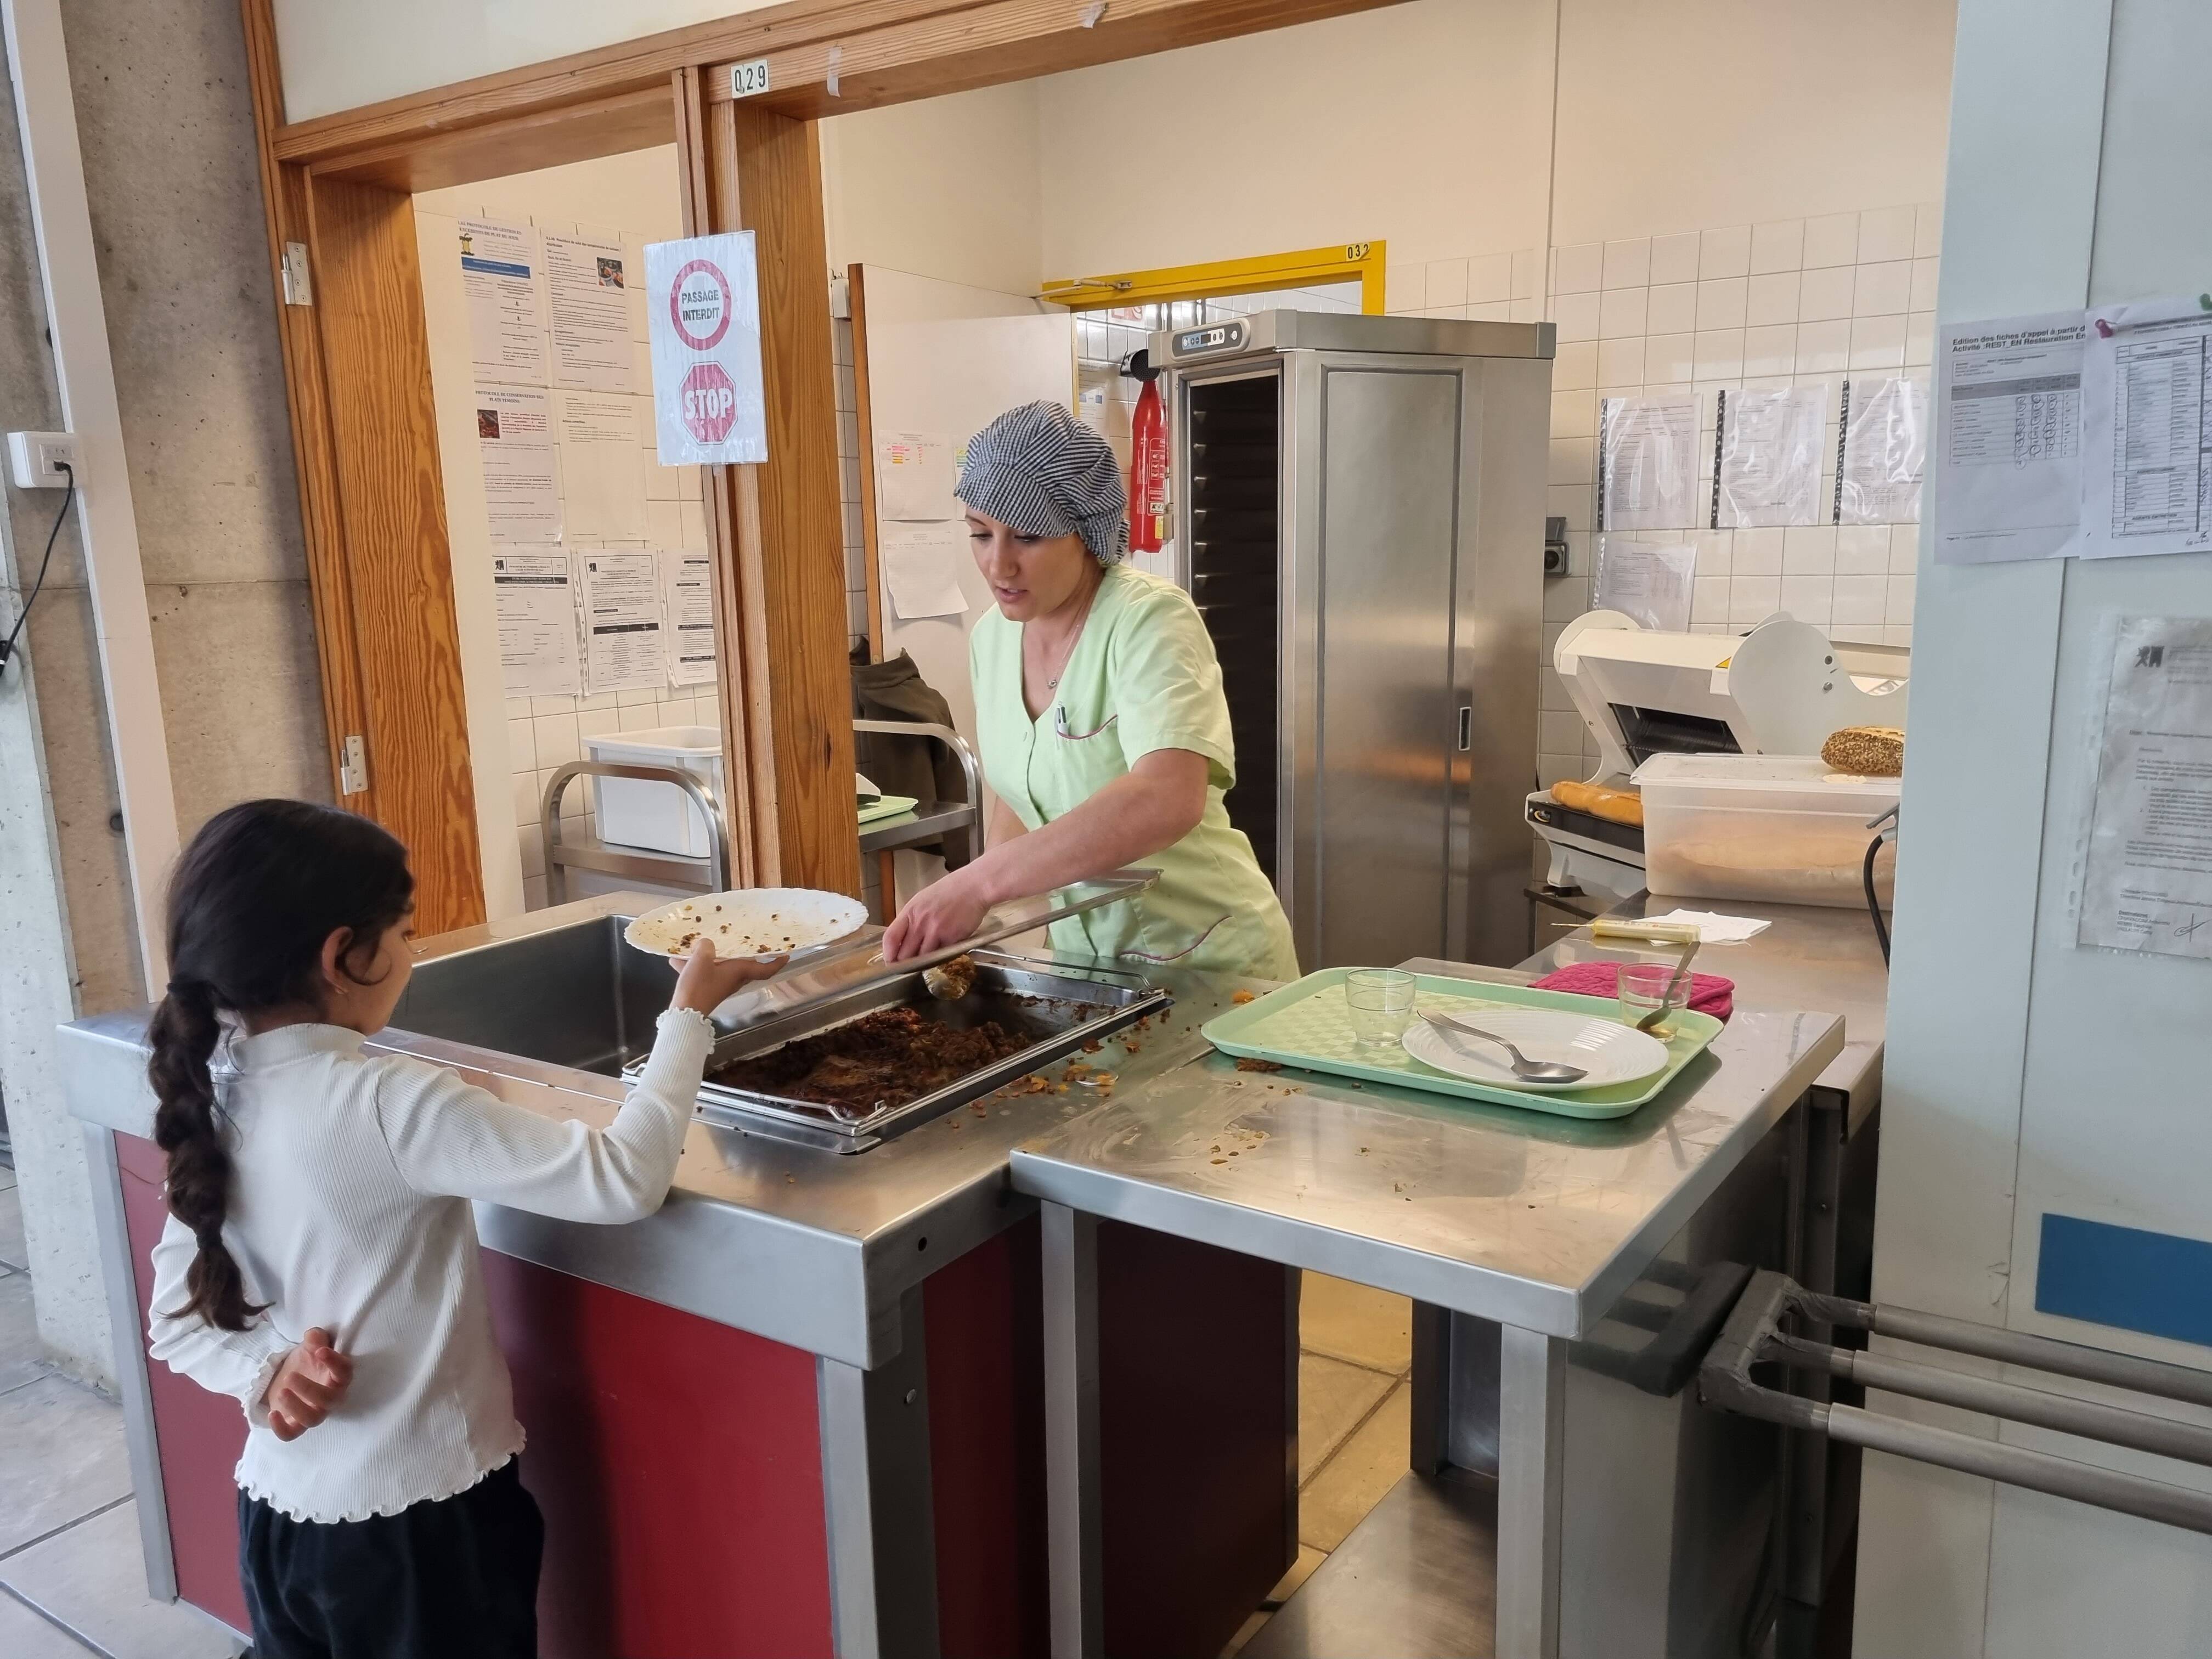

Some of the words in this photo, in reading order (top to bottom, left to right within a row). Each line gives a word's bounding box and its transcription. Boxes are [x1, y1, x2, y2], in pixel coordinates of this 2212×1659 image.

[681, 289, 719, 304] PASSAGE
[682, 307, 720, 321] INTERDIT
[2021, 329, 2049, 338] d'appel
[2057, 325, 2079, 335] partir
[1953, 345, 1980, 353] Activité
[2024, 335, 2074, 345] Restauration
[684, 387, 733, 420] STOP
